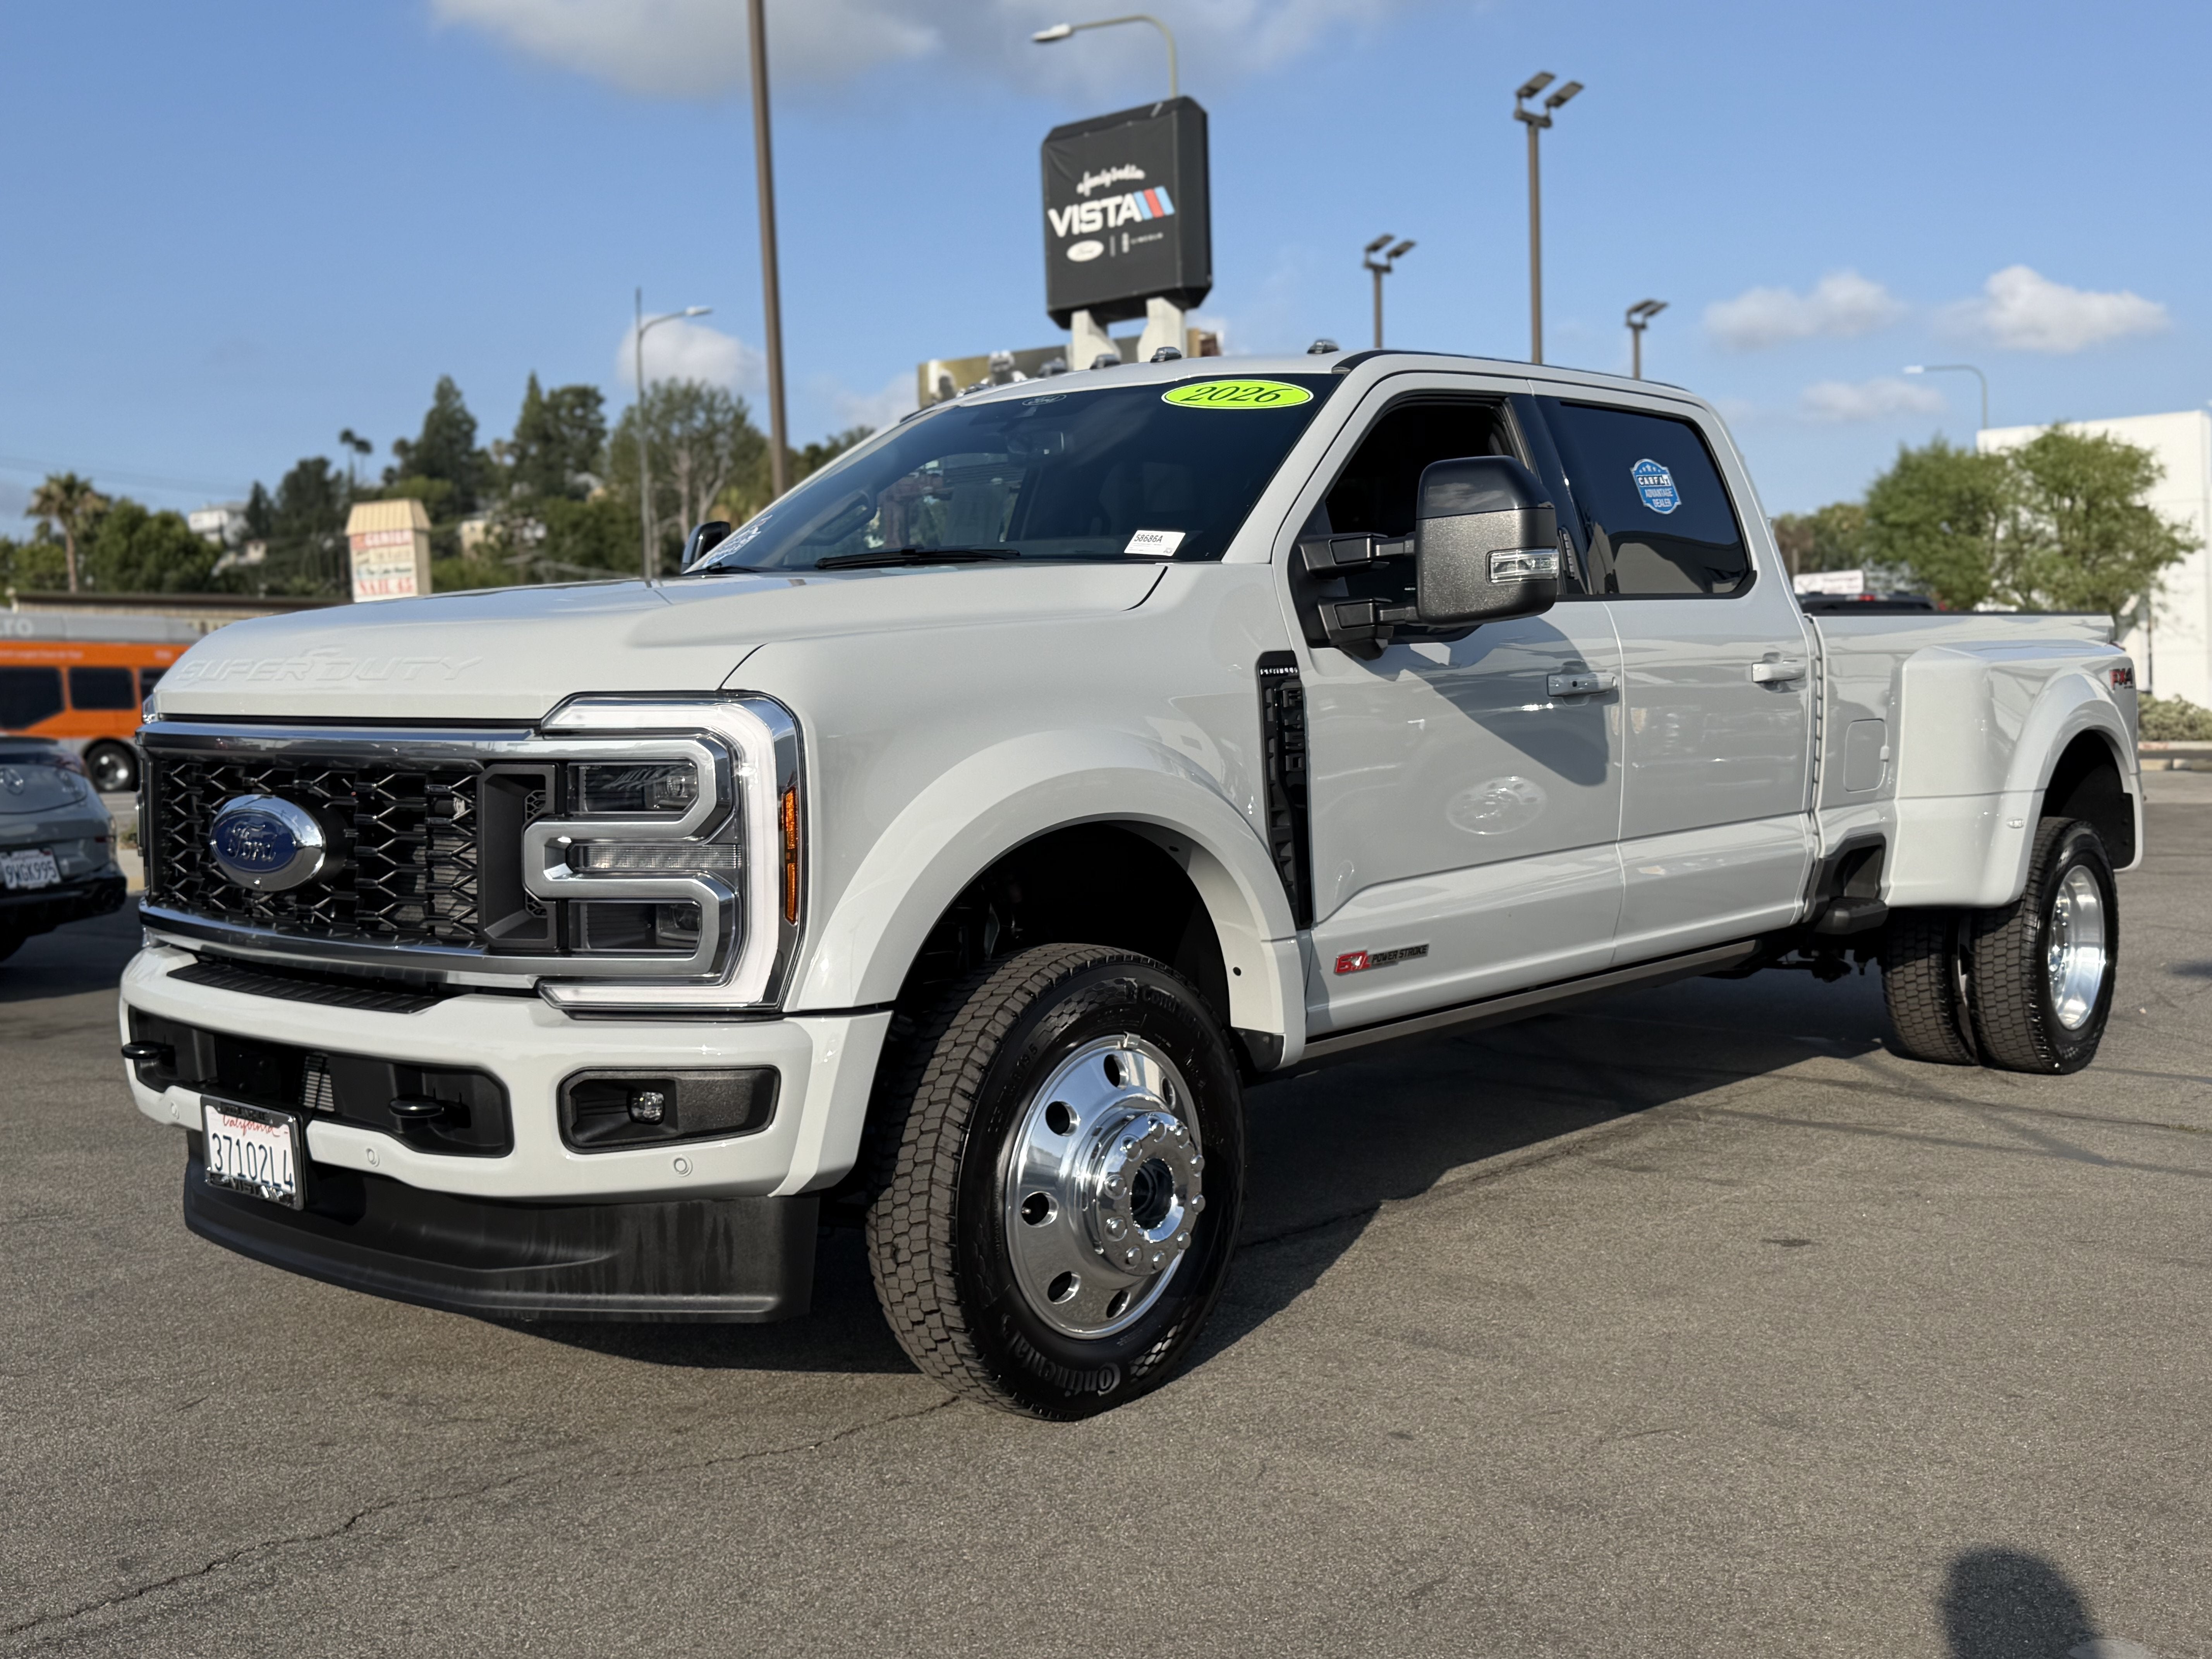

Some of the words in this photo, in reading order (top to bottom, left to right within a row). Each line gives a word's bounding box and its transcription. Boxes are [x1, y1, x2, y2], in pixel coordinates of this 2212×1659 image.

[1048, 193, 1143, 237] VISTA
[1180, 386, 1293, 403] 2026
[1638, 475, 1671, 486] CARFAX
[1134, 534, 1163, 543] 58686A
[177, 657, 312, 682] SUPER
[316, 656, 484, 682] DUTY
[2109, 667, 2133, 690] FX4
[1372, 950, 1398, 964] POWER
[1399, 945, 1428, 958] STROKE
[222, 1114, 280, 1137] California
[212, 1132, 294, 1193] 37102L4
